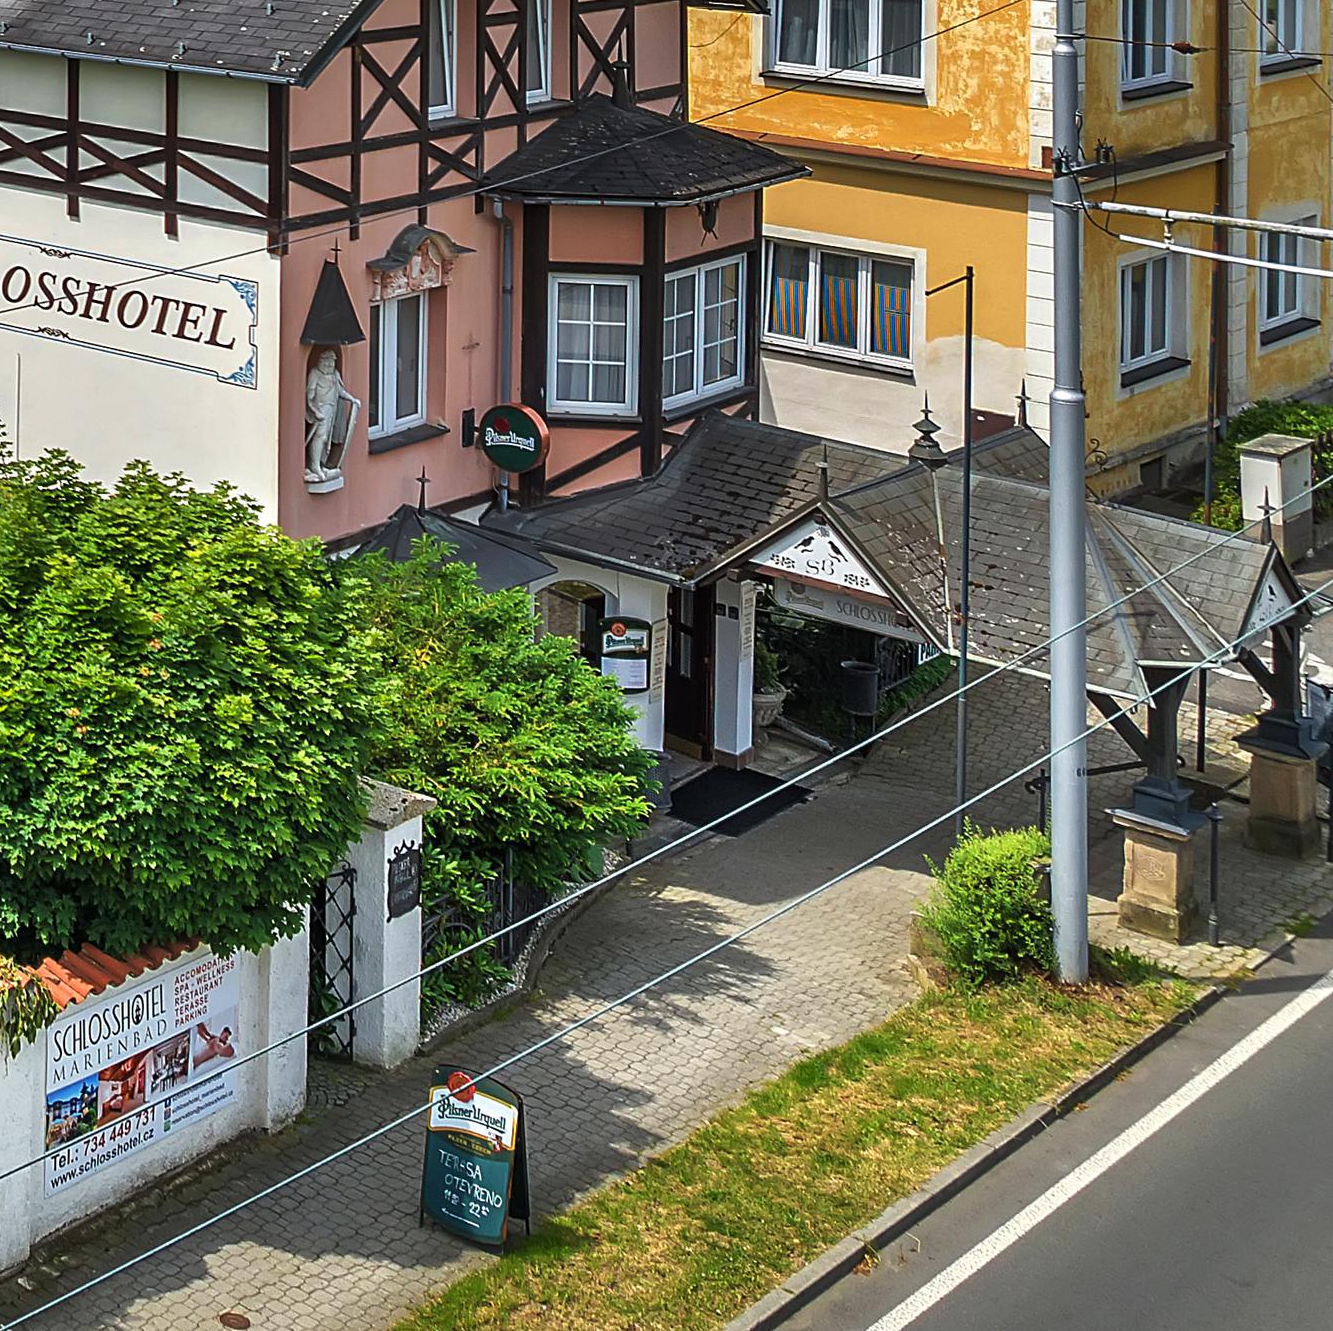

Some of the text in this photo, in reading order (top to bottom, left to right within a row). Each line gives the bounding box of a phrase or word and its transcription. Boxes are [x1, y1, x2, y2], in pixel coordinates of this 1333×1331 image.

[174, 983, 189, 996] SPA
[196, 960, 235, 986] WELLNESS
[174, 976, 223, 1007] RESTAURANT
[53, 983, 167, 1062] SCHLOSSHOTEL
[174, 994, 209, 1017] TERASSE
[174, 1005, 208, 1028] PARKING
[53, 1019, 167, 1084] MARIENBAD
[438, 1094, 506, 1130] Pilsner Urquell
[51, 1107, 156, 1171] Tel.: 734 449 731
[51, 1128, 154, 1189] www.schlosshotel.cz
